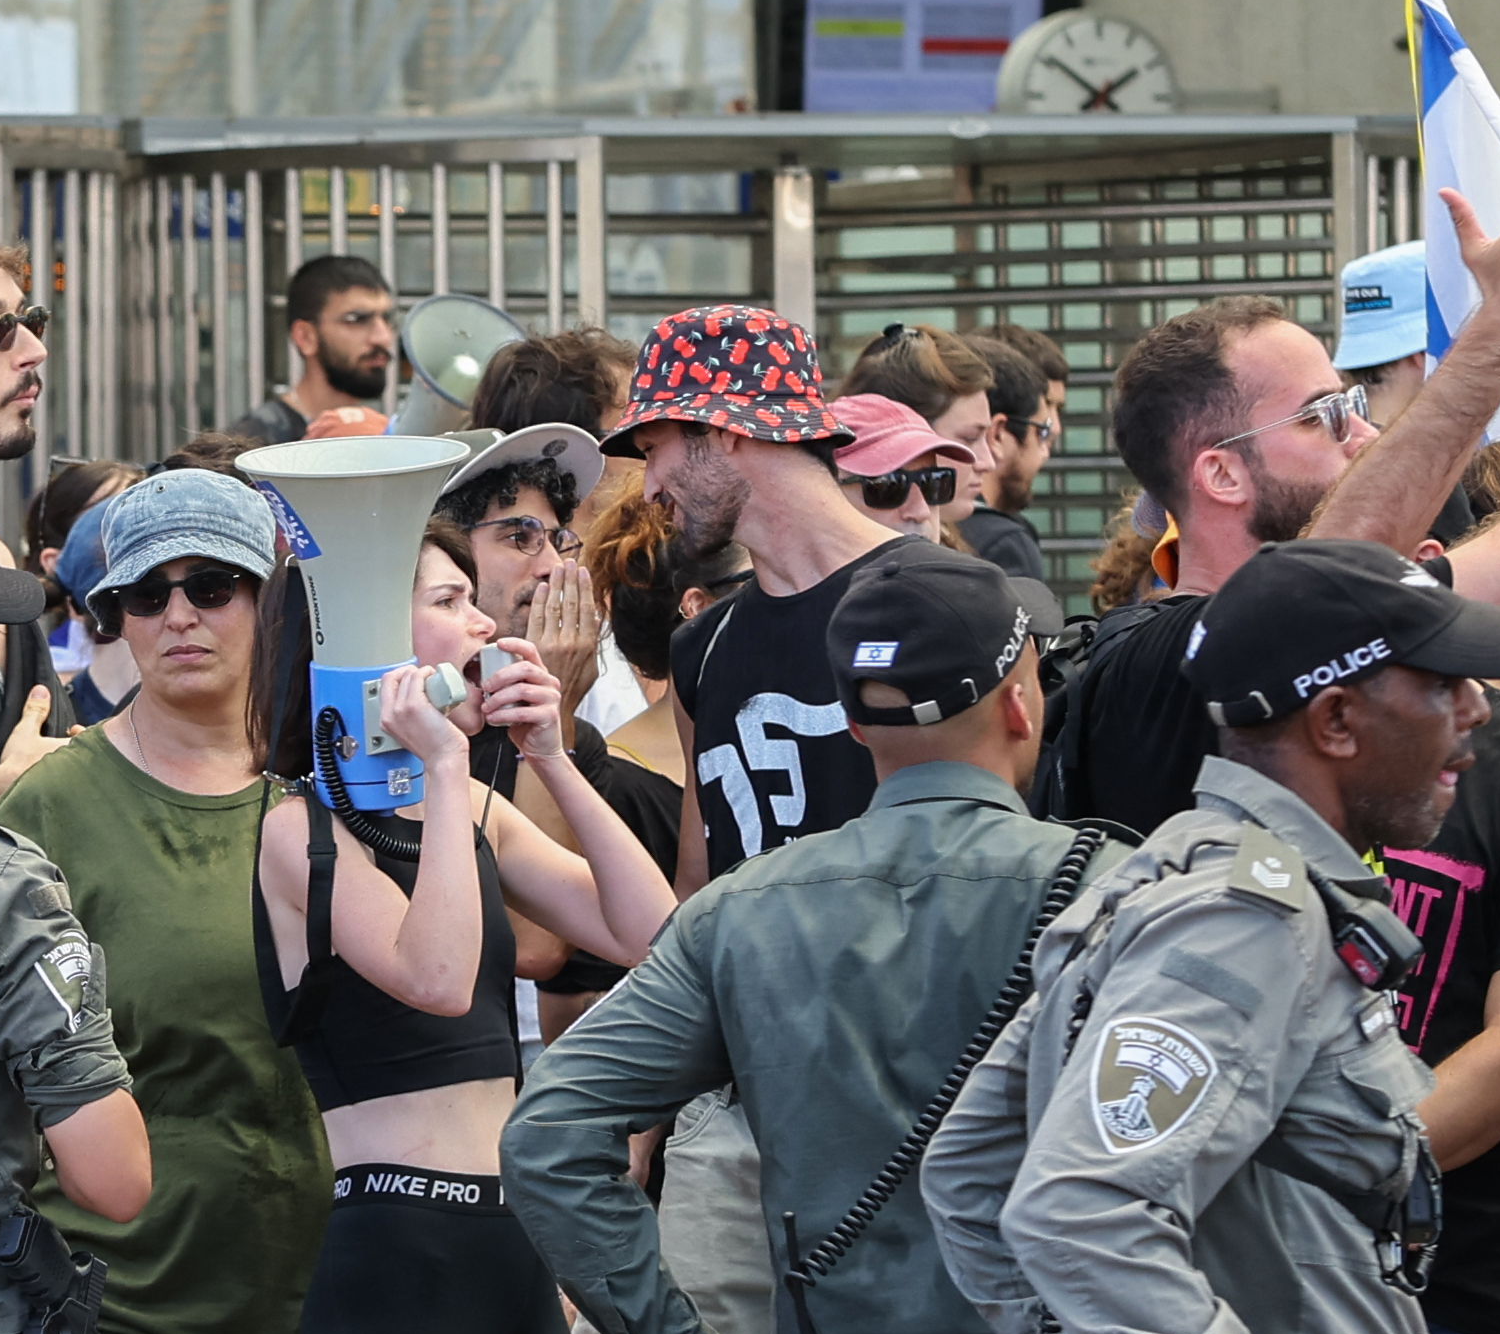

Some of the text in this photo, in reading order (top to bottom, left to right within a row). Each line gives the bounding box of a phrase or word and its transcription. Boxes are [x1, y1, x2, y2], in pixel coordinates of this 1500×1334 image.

[993, 605, 1033, 679] POLICE
[1291, 636, 1393, 699] POLICE
[43, 942, 74, 965] ישראל
[1113, 1026, 1209, 1079] משטרת ישראל
[364, 1172, 429, 1198] NIKE
[430, 1179, 481, 1205] PRO
